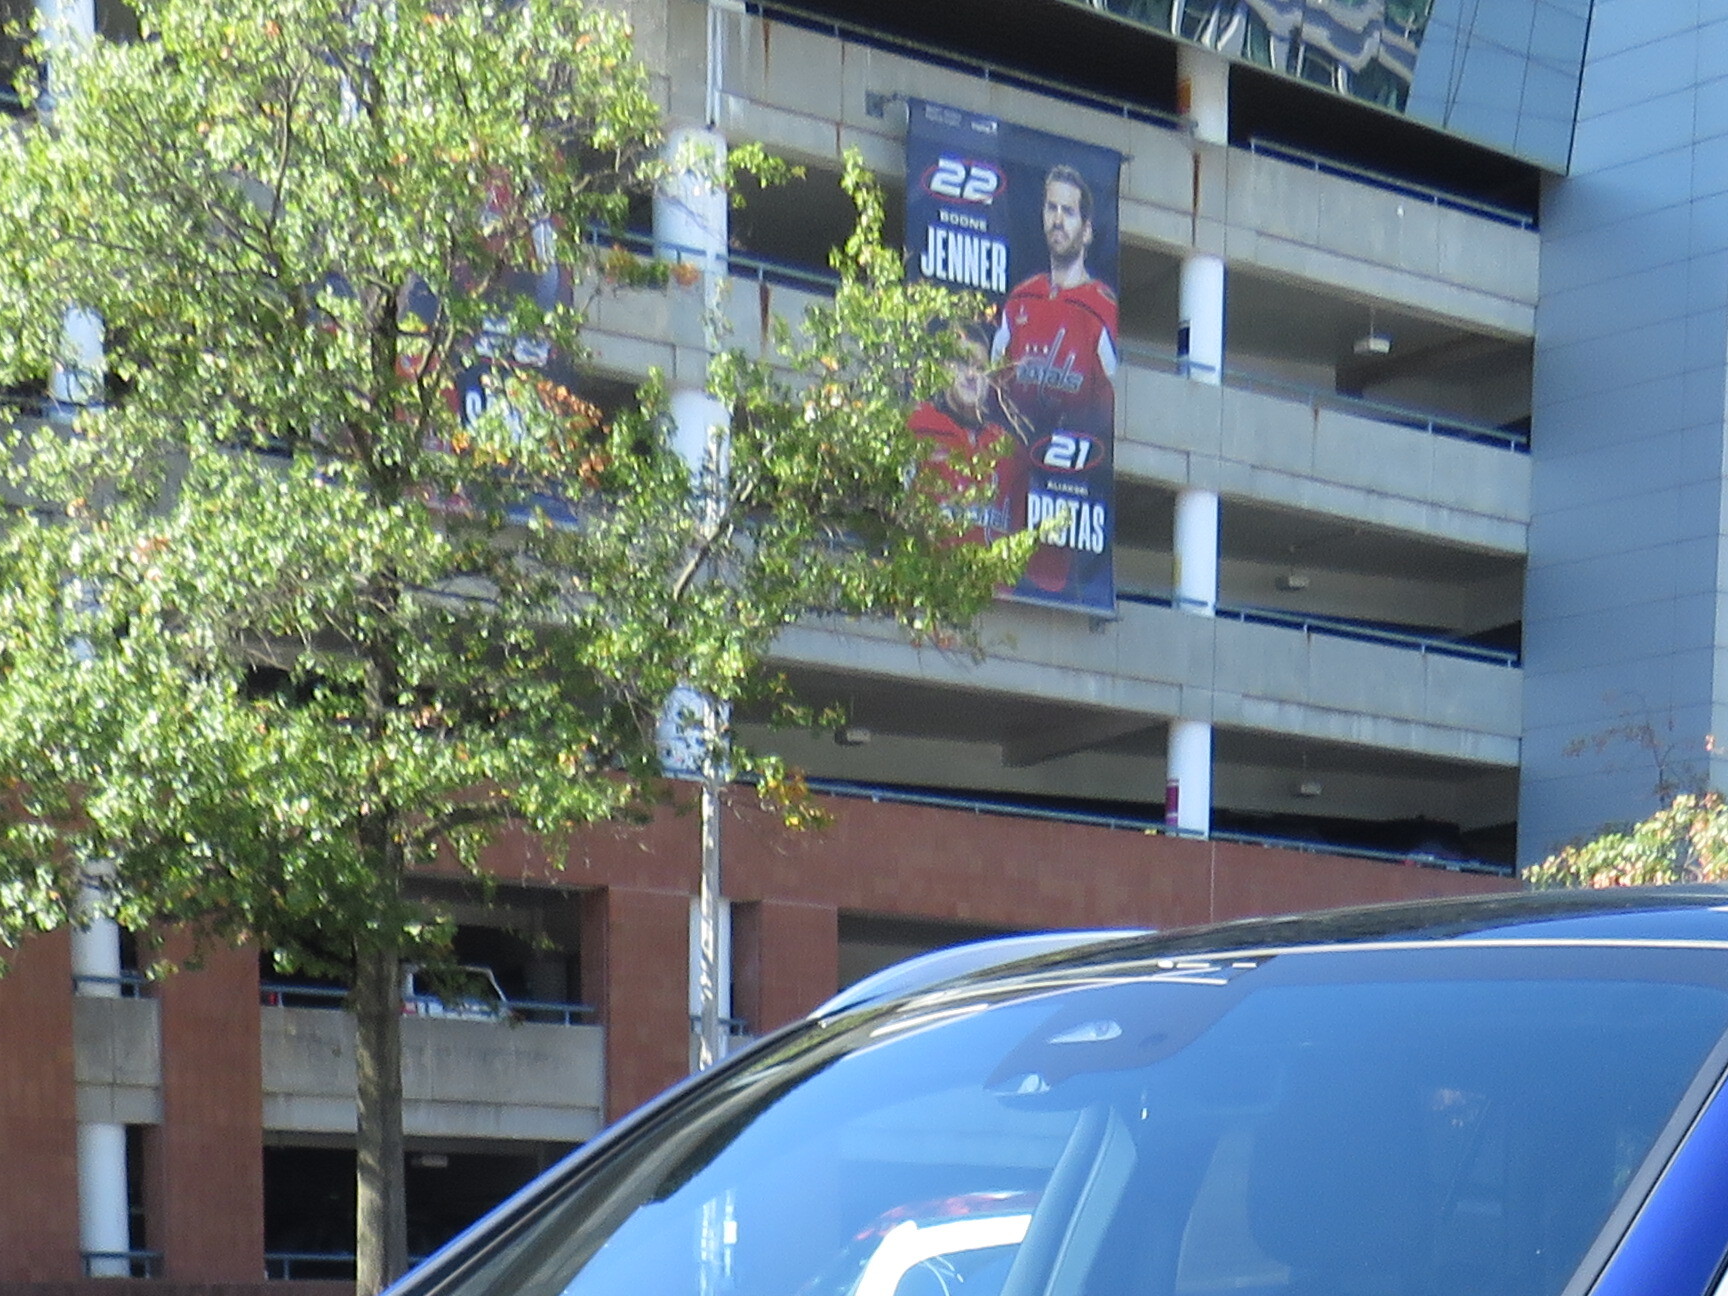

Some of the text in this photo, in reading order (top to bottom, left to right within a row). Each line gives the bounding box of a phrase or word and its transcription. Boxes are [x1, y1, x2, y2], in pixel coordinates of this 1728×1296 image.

[930, 157, 999, 205] 22
[939, 209, 988, 233] BOONE
[920, 224, 1007, 294] JENNER
[1043, 434, 1091, 470] 21
[1027, 492, 1105, 554] PROTAS
